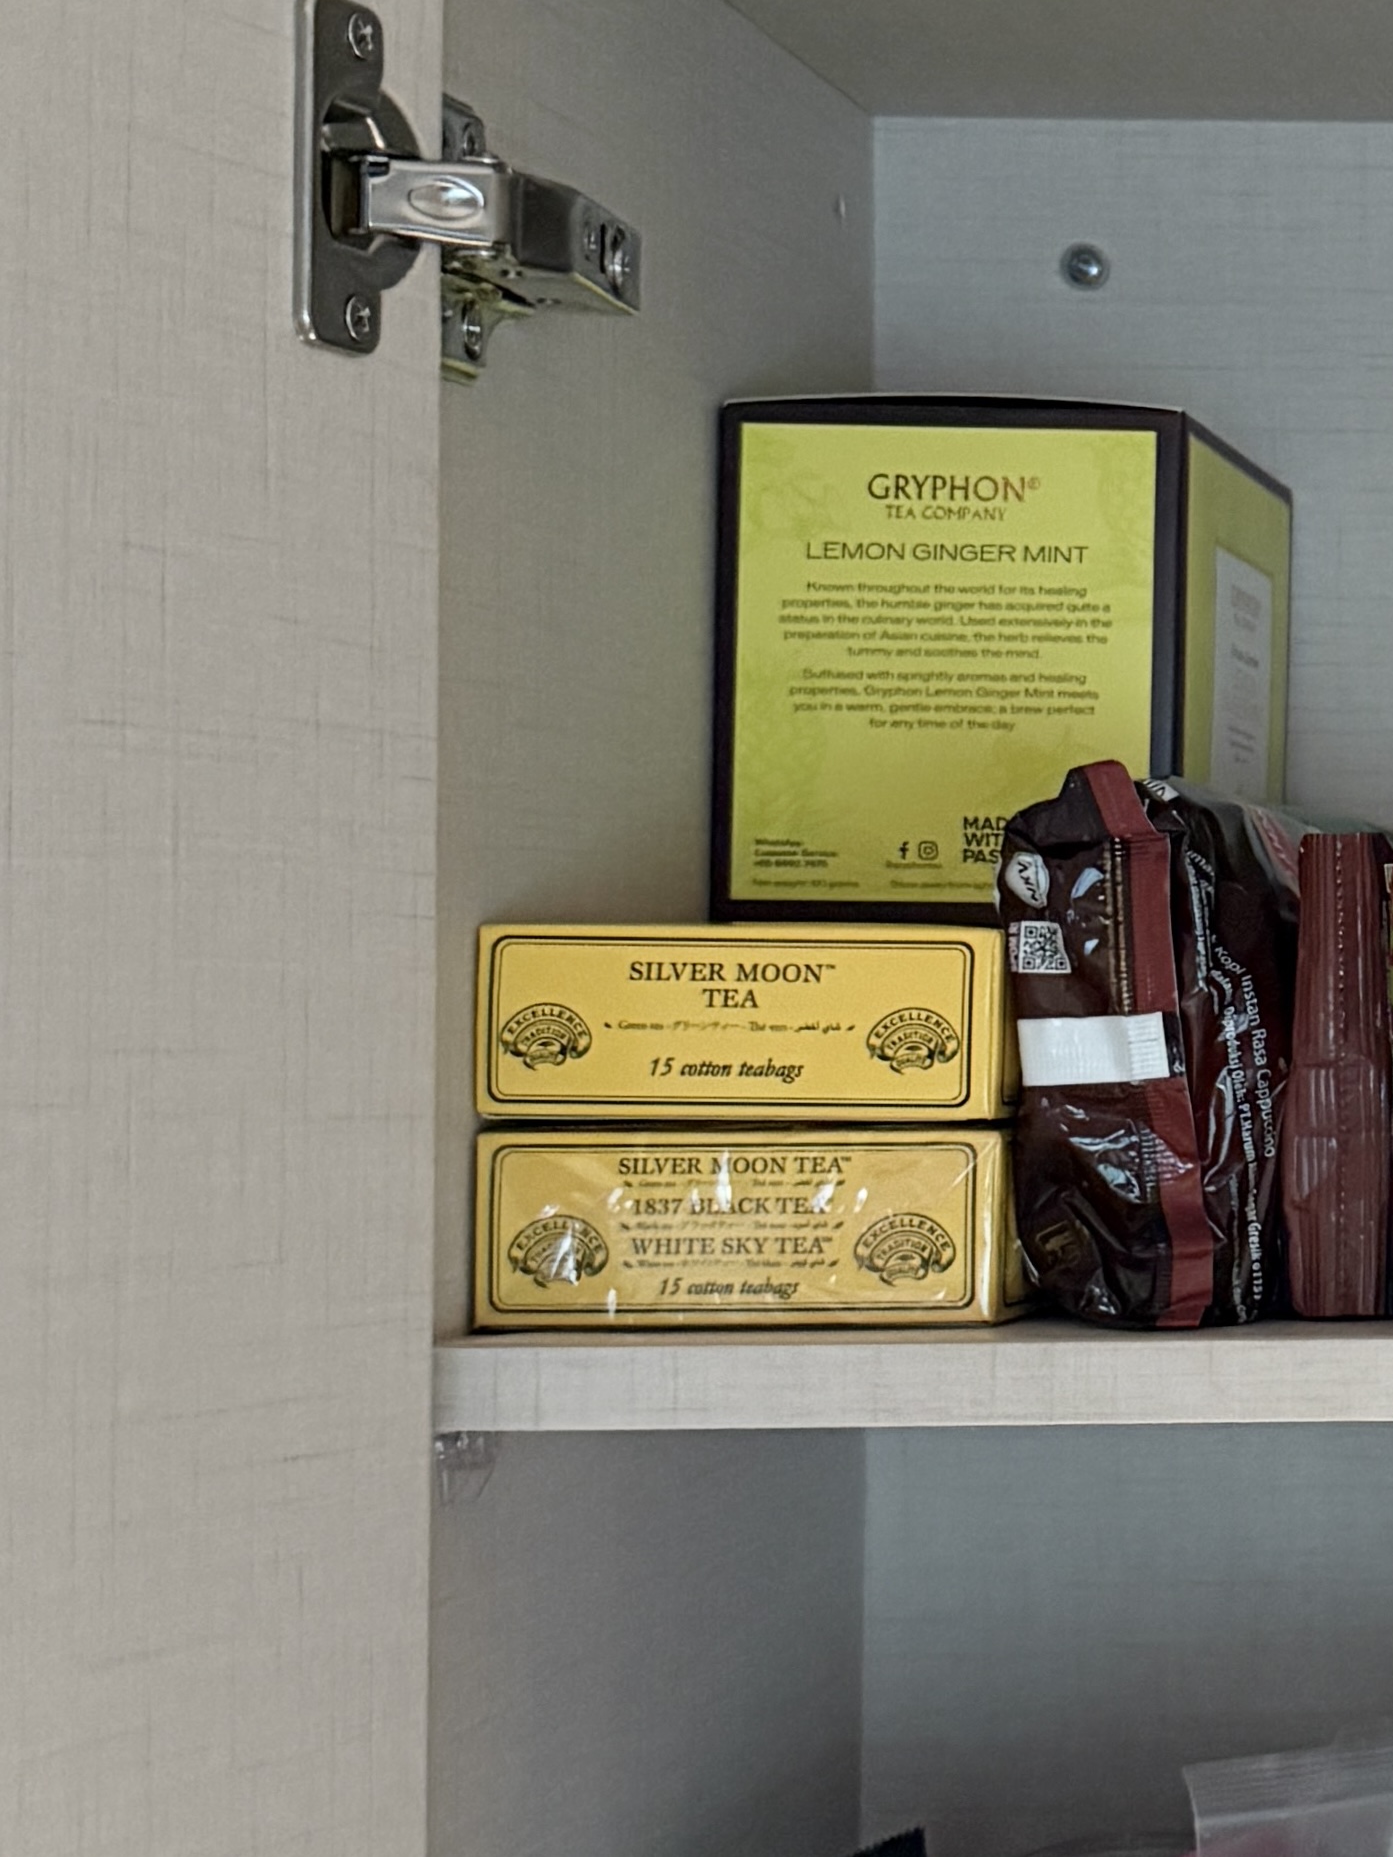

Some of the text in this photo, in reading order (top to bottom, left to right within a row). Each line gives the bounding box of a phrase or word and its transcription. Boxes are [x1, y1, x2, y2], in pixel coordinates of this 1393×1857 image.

[886, 505, 1006, 521] TEA COMPANY
[806, 542, 1089, 564] LEMON GINGER MINT
[963, 817, 1007, 831] MAD
[963, 833, 1003, 847] WIT
[629, 961, 726, 983] SILVER
[703, 988, 759, 1009] TEA
[506, 1007, 587, 1038] EXCELLENCE
[874, 1011, 956, 1042] EXCELLENCE
[1214, 946, 1277, 1158] Kopi Instan Rasa Cappuccino
[651, 1057, 804, 1084] 15 cotton teabags
[618, 1157, 703, 1175] SILVER
[711, 1156, 787, 1174] MOON
[633, 1197, 688, 1215] 1837
[690, 1196, 771, 1215] BLACK
[516, 1219, 602, 1253] EXCELLNCE
[861, 1217, 952, 1252] EXCELLENCE
[1247, 1222, 1263, 1261] Gresik
[631, 1238, 716, 1256] WHITE
[720, 1237, 774, 1256] SKY
[659, 1277, 801, 1300] 15 cotton teabags
